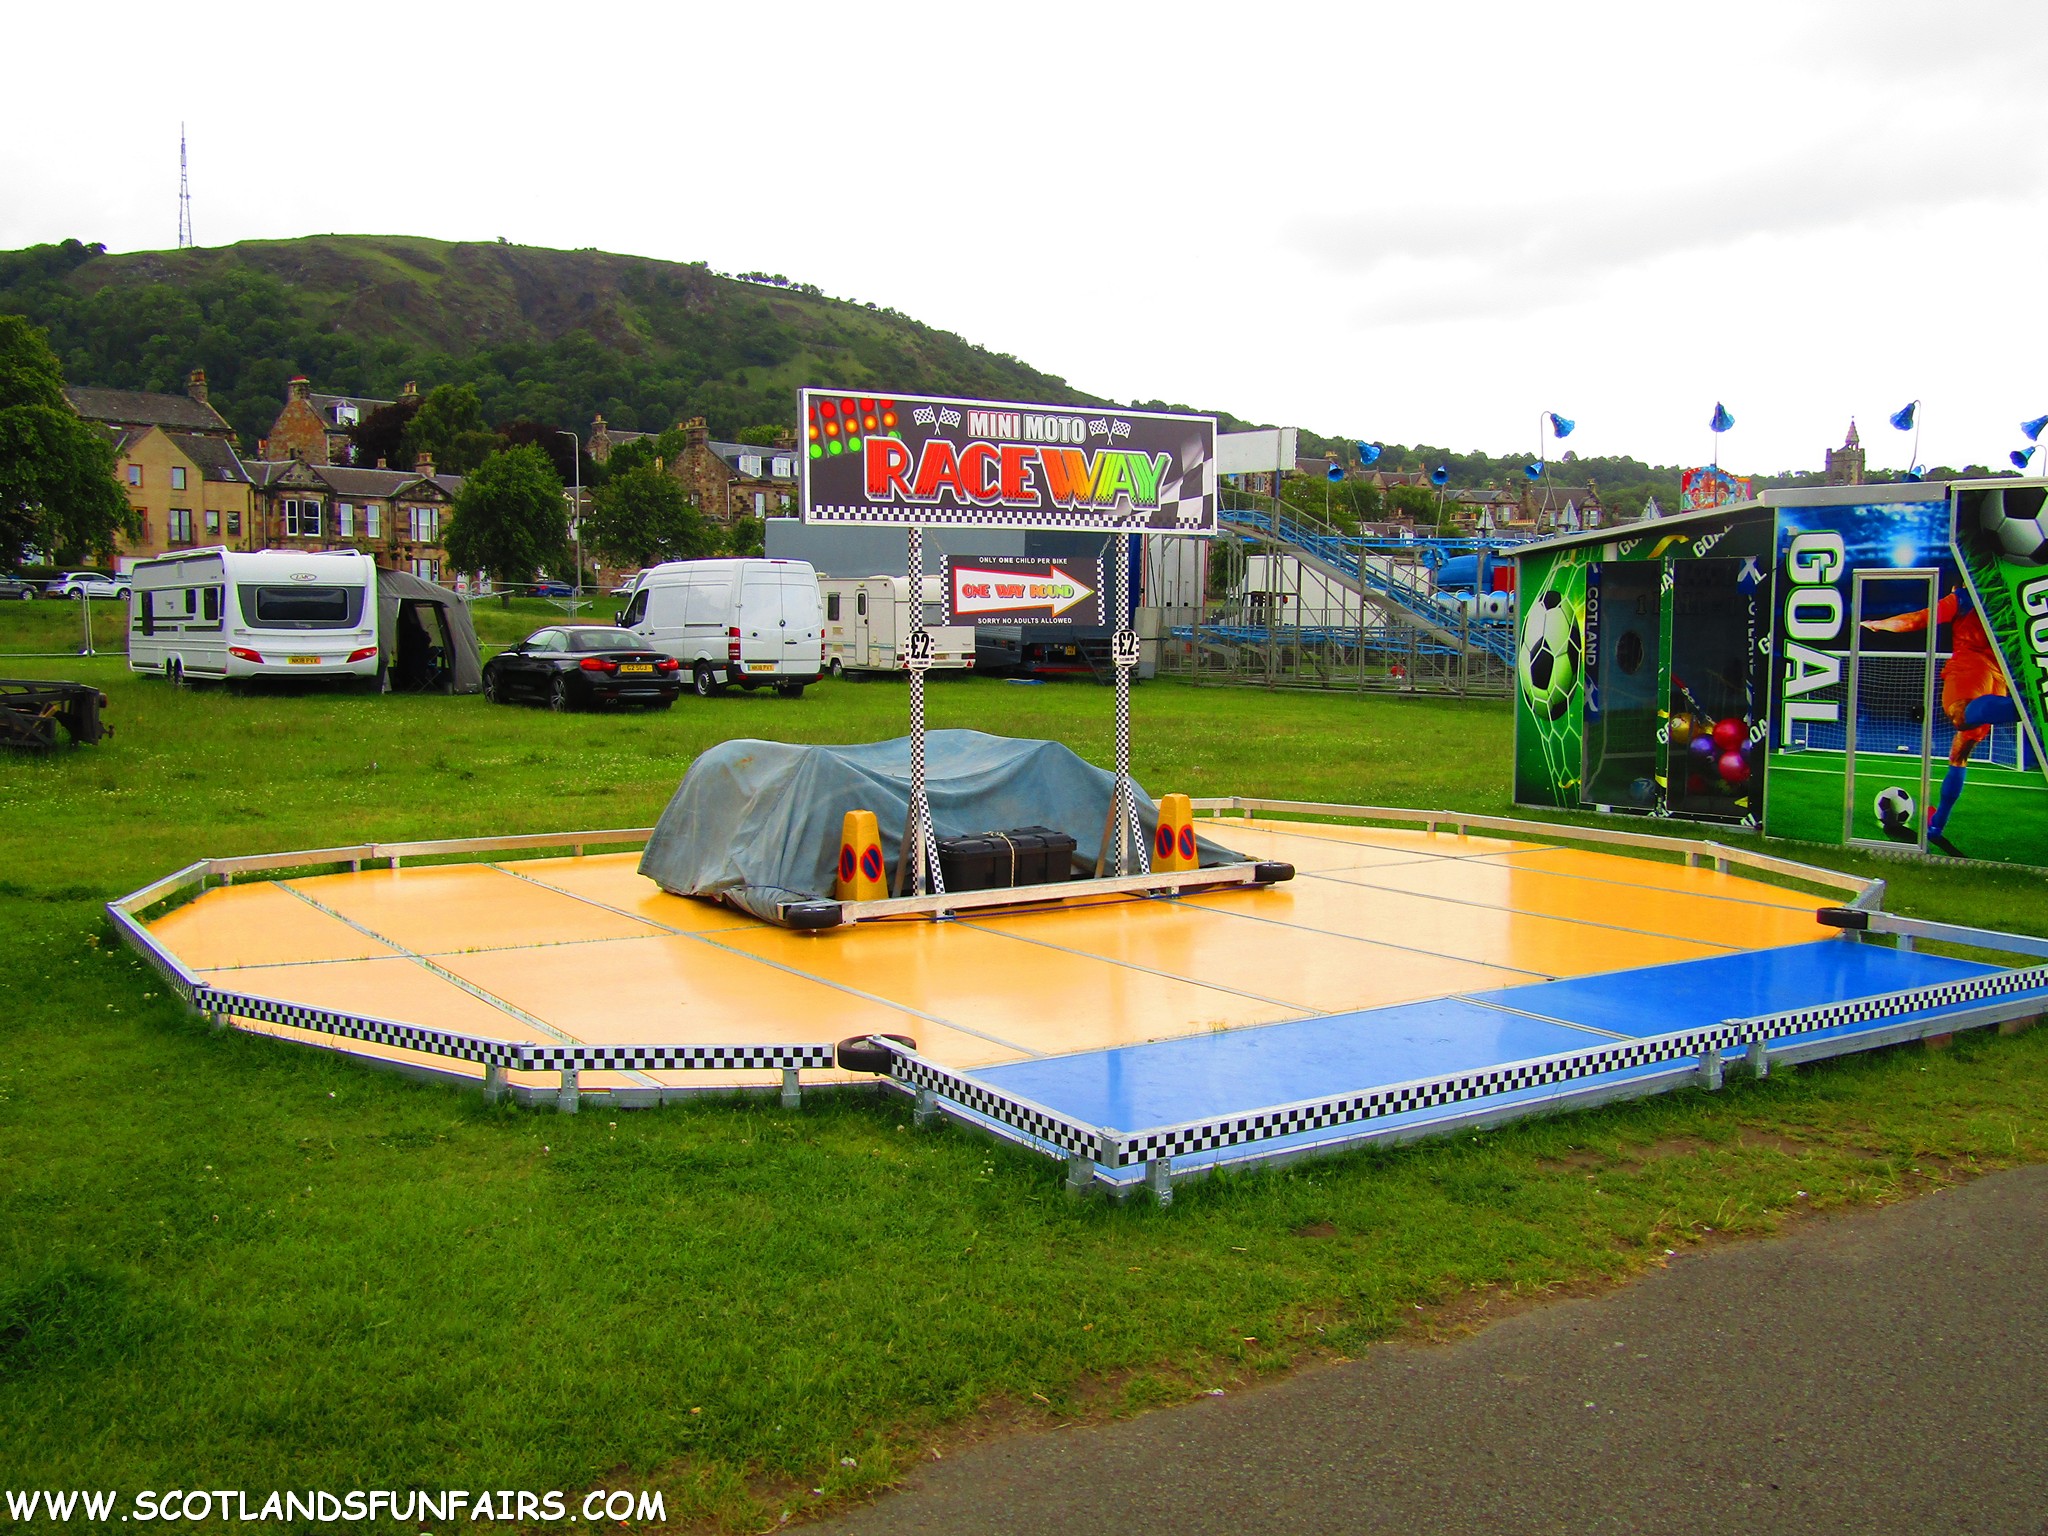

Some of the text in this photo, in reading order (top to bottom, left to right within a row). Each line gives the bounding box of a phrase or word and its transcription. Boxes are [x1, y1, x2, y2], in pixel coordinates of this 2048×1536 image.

[968, 410, 1086, 444] MINI MOTO
[864, 435, 1173, 511] RACEWAY
[962, 583, 1075, 599] ONE WAY ROUND
[911, 633, 930, 659] £2
[1118, 632, 1135, 656] £2
[1781, 529, 1846, 747] GOAL
